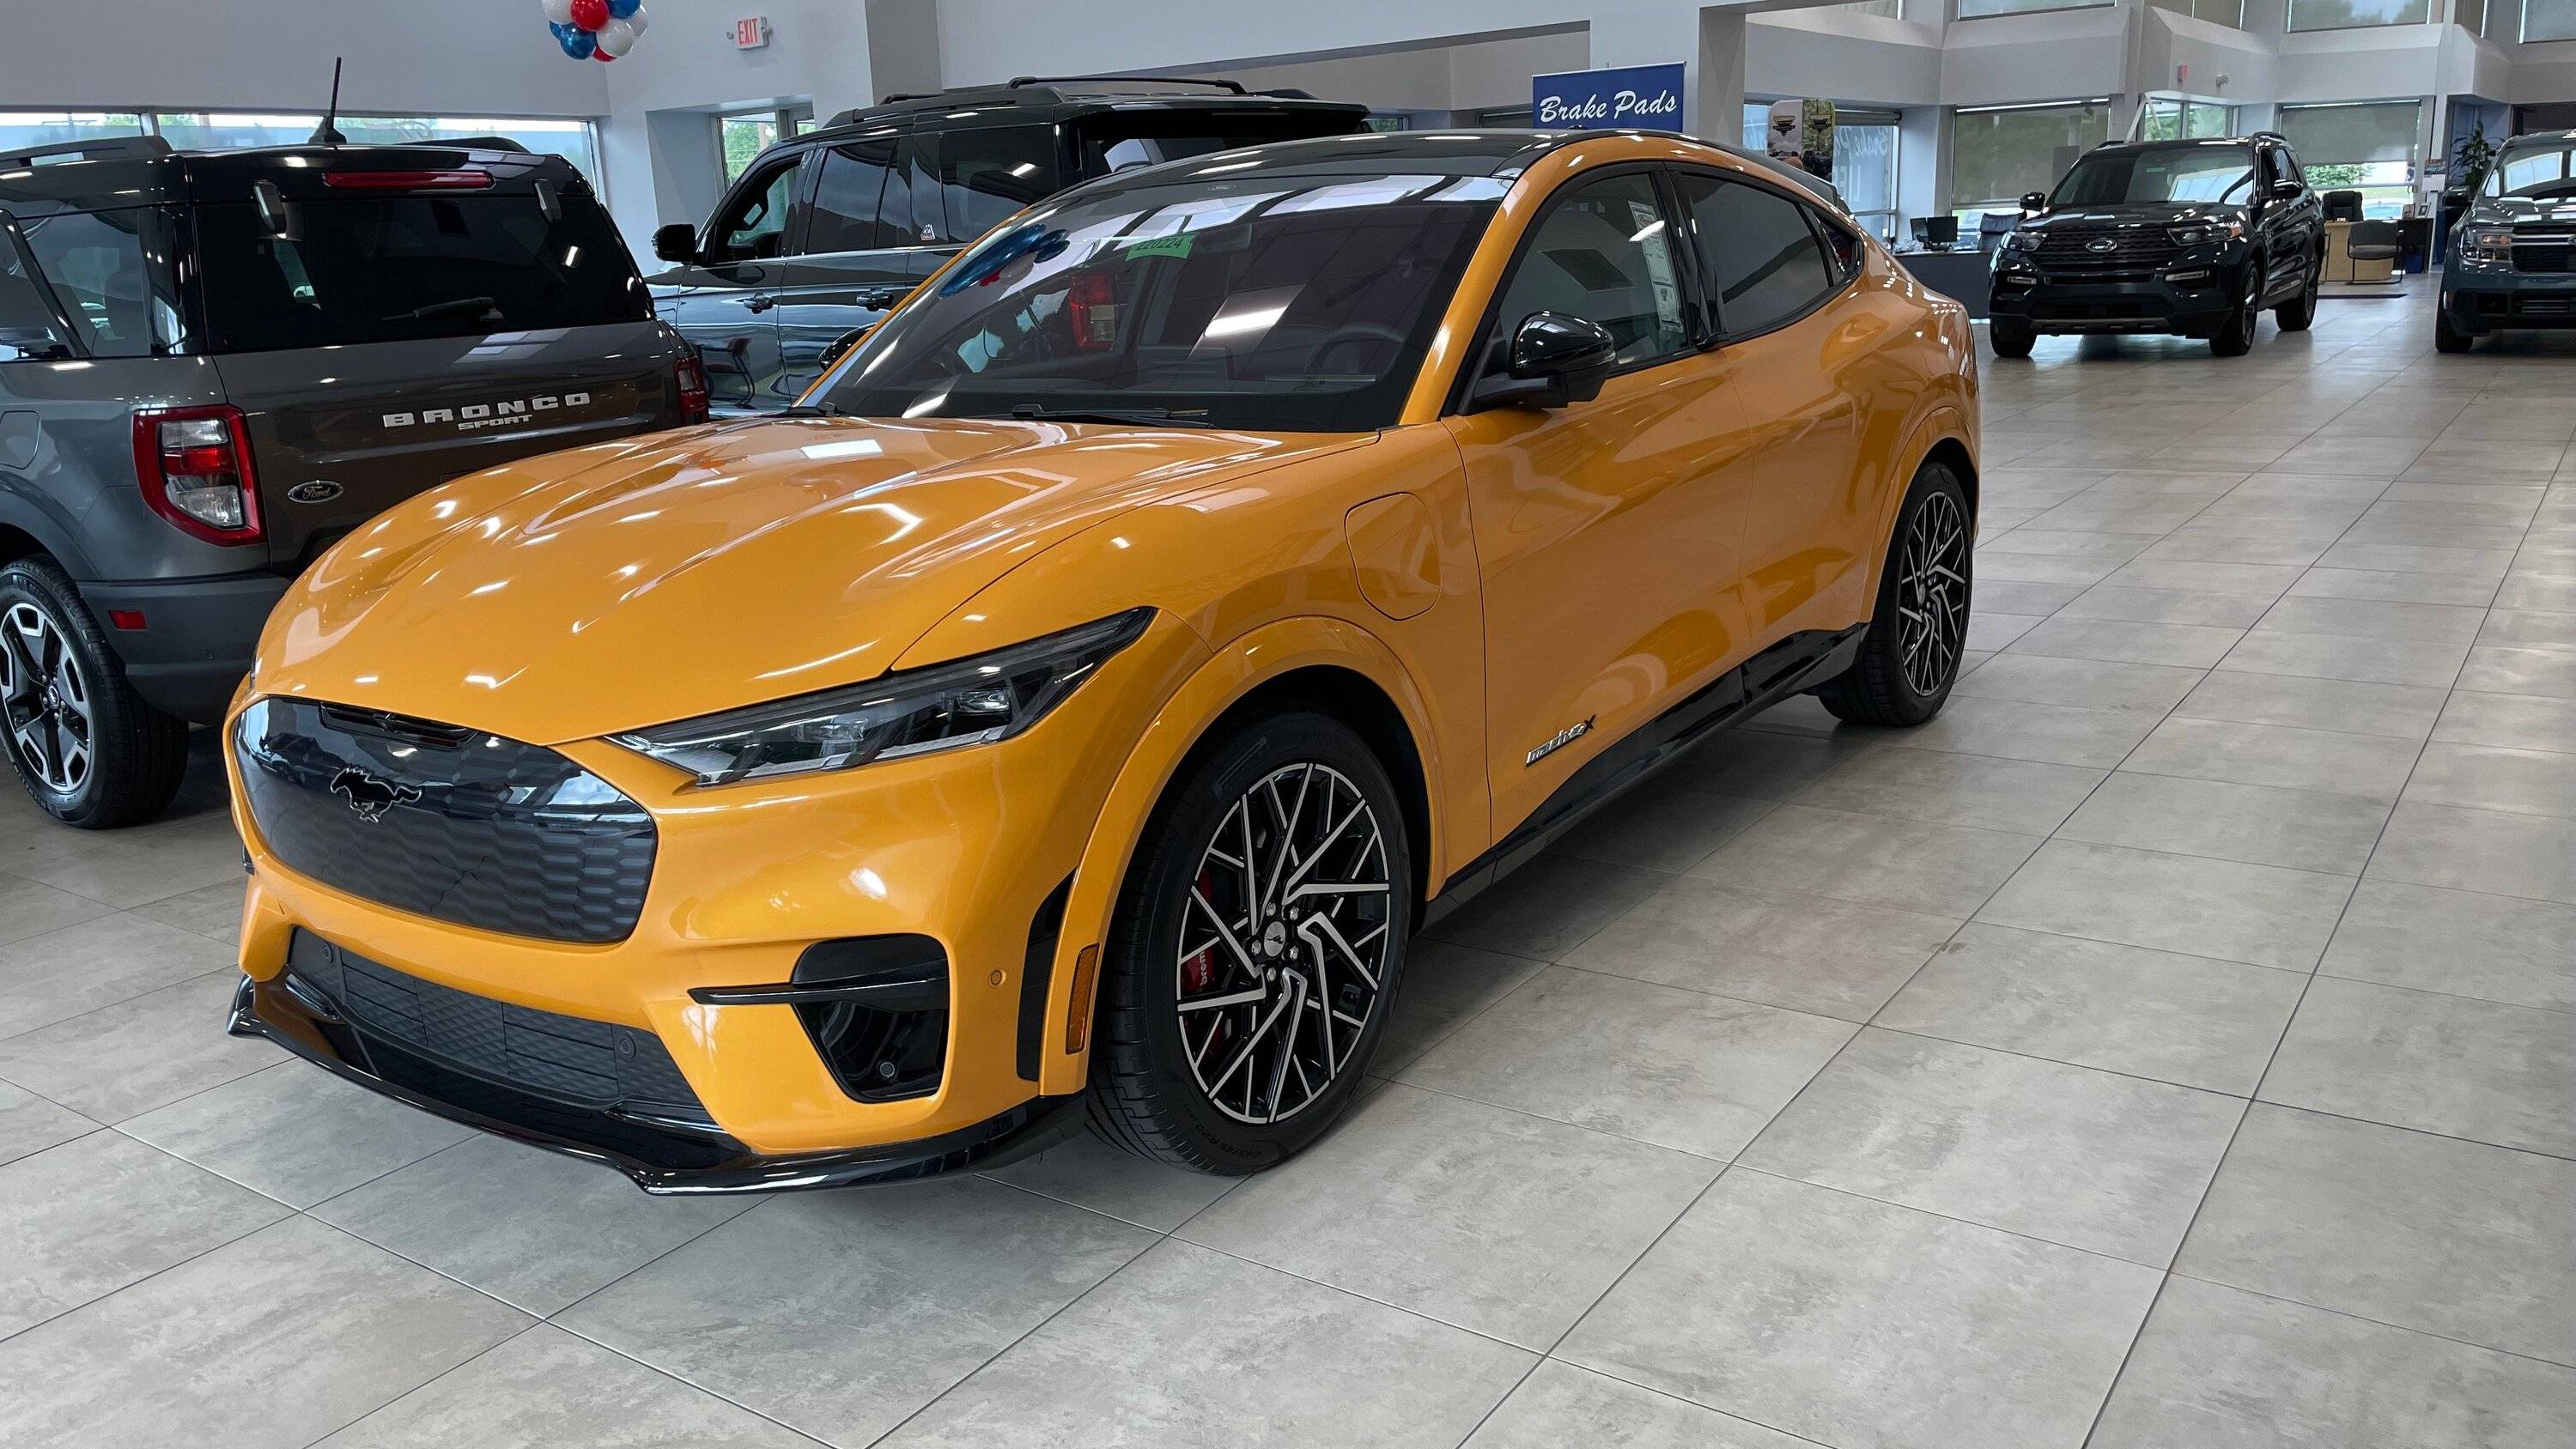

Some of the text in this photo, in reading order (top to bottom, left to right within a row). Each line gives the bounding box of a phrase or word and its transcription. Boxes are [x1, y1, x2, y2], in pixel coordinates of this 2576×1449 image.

[738, 19, 757, 45] EXIT
[1540, 90, 1677, 123] Brake Pads
[383, 392, 590, 427] BRONCO
[459, 414, 532, 430] SPORT
[302, 485, 331, 500] Ford
